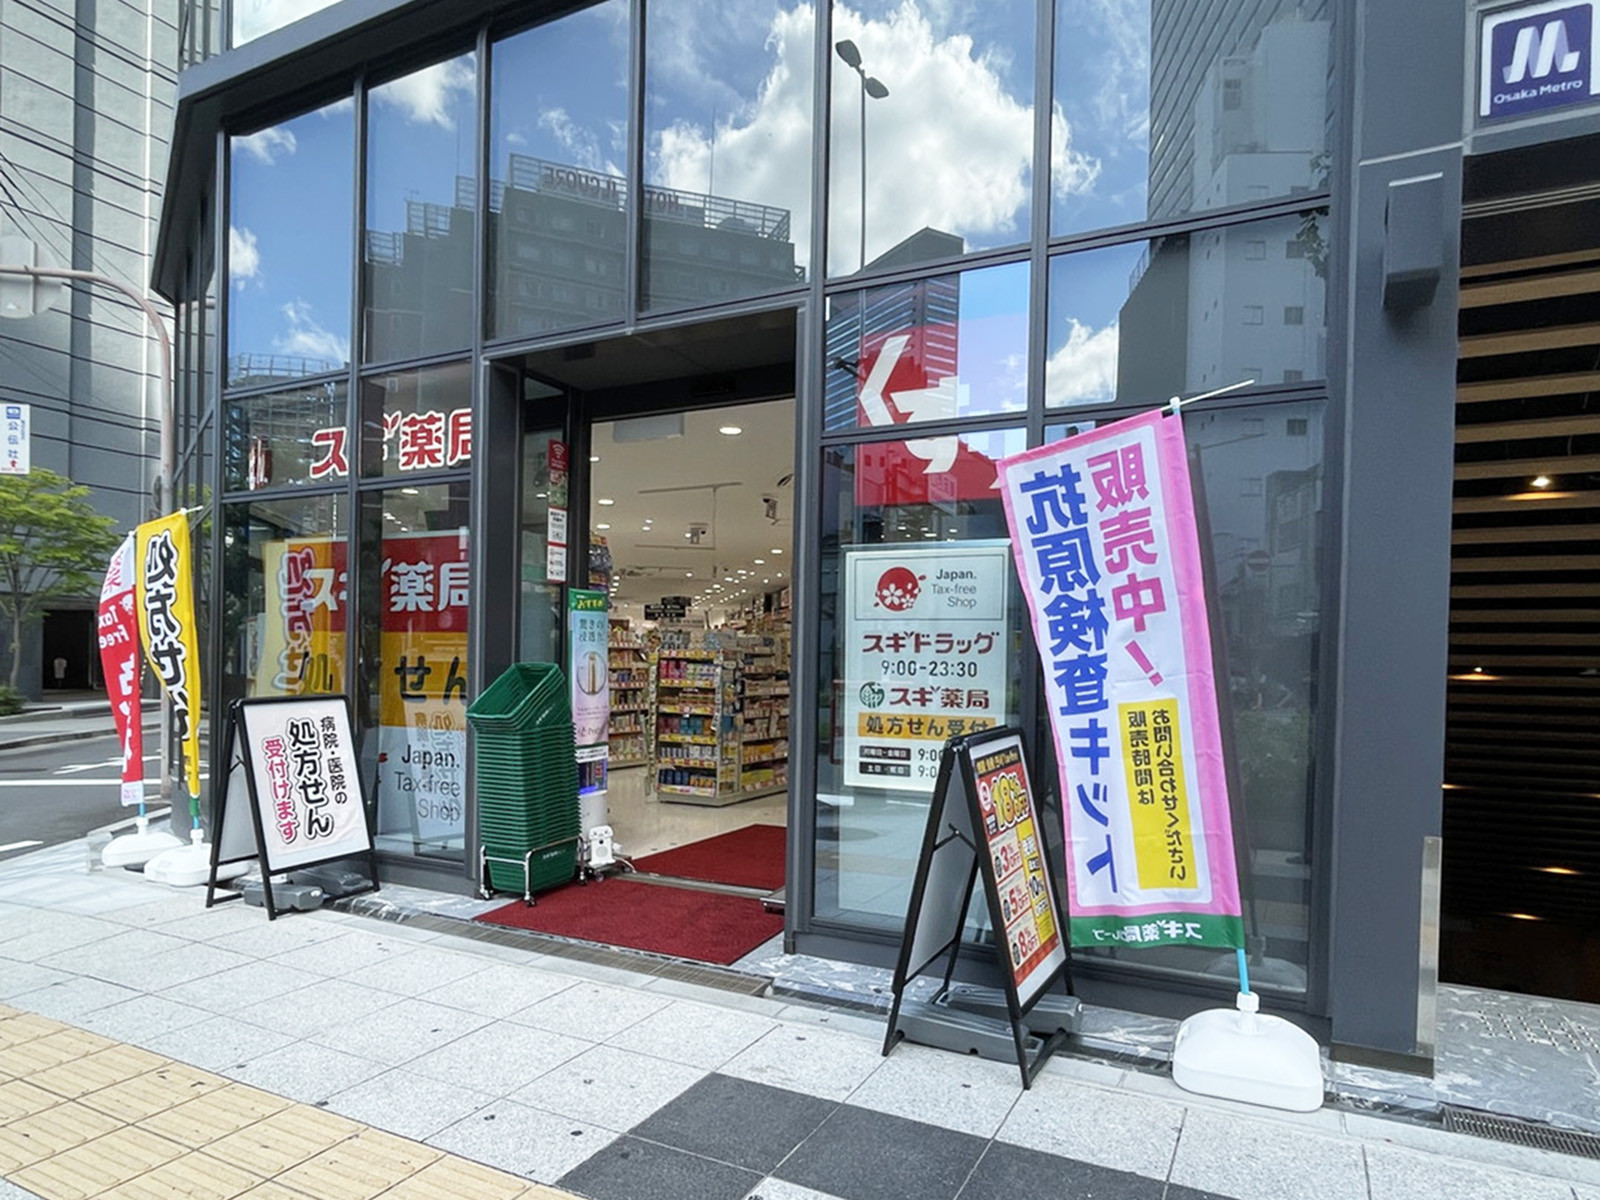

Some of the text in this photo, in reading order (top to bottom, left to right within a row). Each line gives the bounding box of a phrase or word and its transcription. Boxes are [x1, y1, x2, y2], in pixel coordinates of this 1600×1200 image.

[1493, 79, 1583, 104] Osaka Metro
[309, 408, 472, 479] ス薬局
[302, 558, 469, 613] ス薬局
[935, 568, 977, 582] Japan.
[931, 583, 977, 595] Tax-free
[947, 596, 977, 609] Shop
[862, 631, 1000, 654] スギドラッグ
[880, 660, 978, 678] 9:00-23:30
[889, 685, 990, 710] スギ薬局
[866, 715, 990, 738] 処方せん受付
[401, 744, 460, 770] Japan.
[264, 737, 295, 841] 受付けます
[287, 719, 332, 838] 処方せん
[394, 771, 461, 797] Tax-free
[417, 798, 461, 826] Shop
